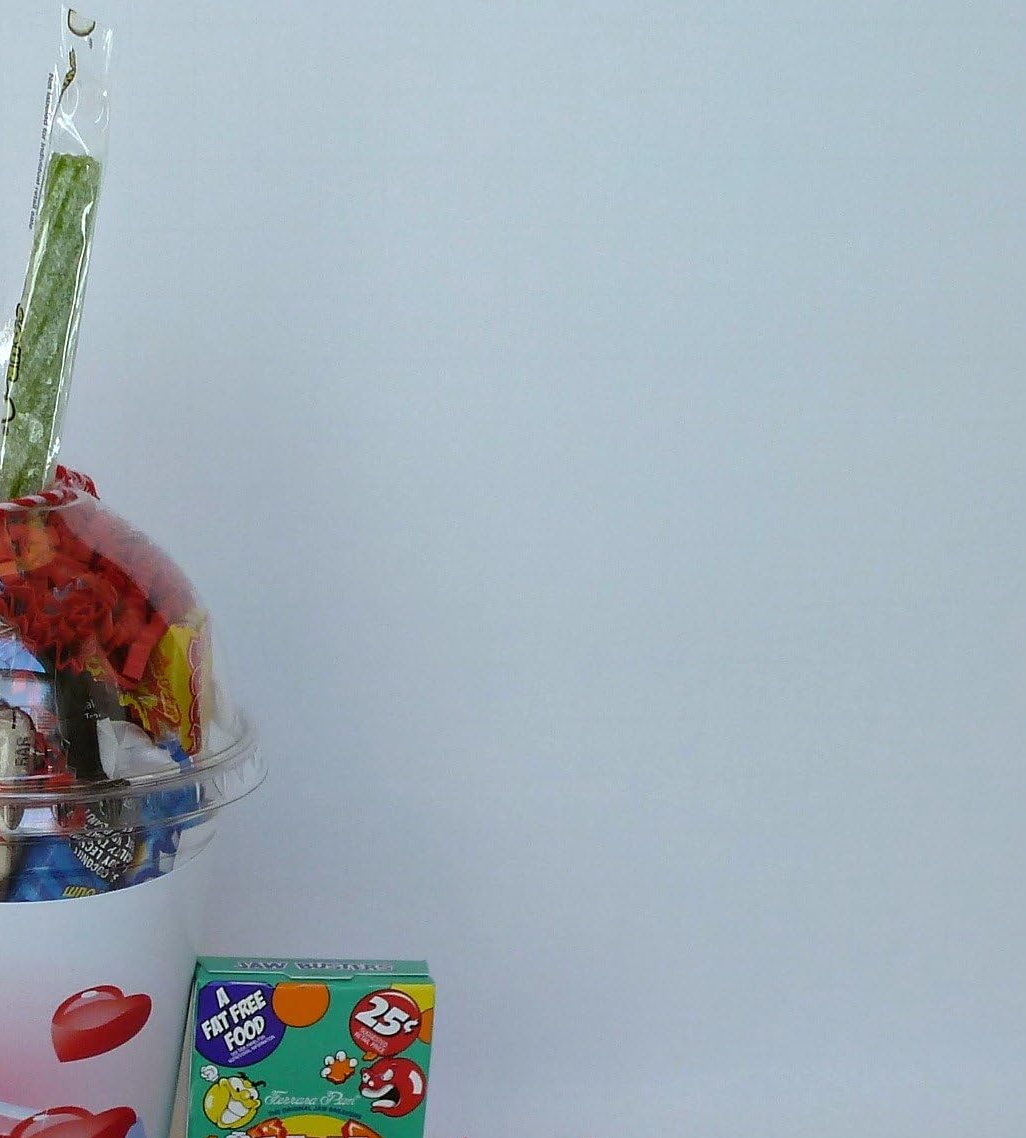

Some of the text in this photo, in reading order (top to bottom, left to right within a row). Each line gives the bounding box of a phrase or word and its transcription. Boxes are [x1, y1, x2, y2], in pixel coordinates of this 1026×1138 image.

[216, 987, 231, 1008] A
[201, 990, 268, 1041] FAT FREE
[224, 1016, 265, 1052] FOOD
[265, 1090, 318, 1107] Ferrara
